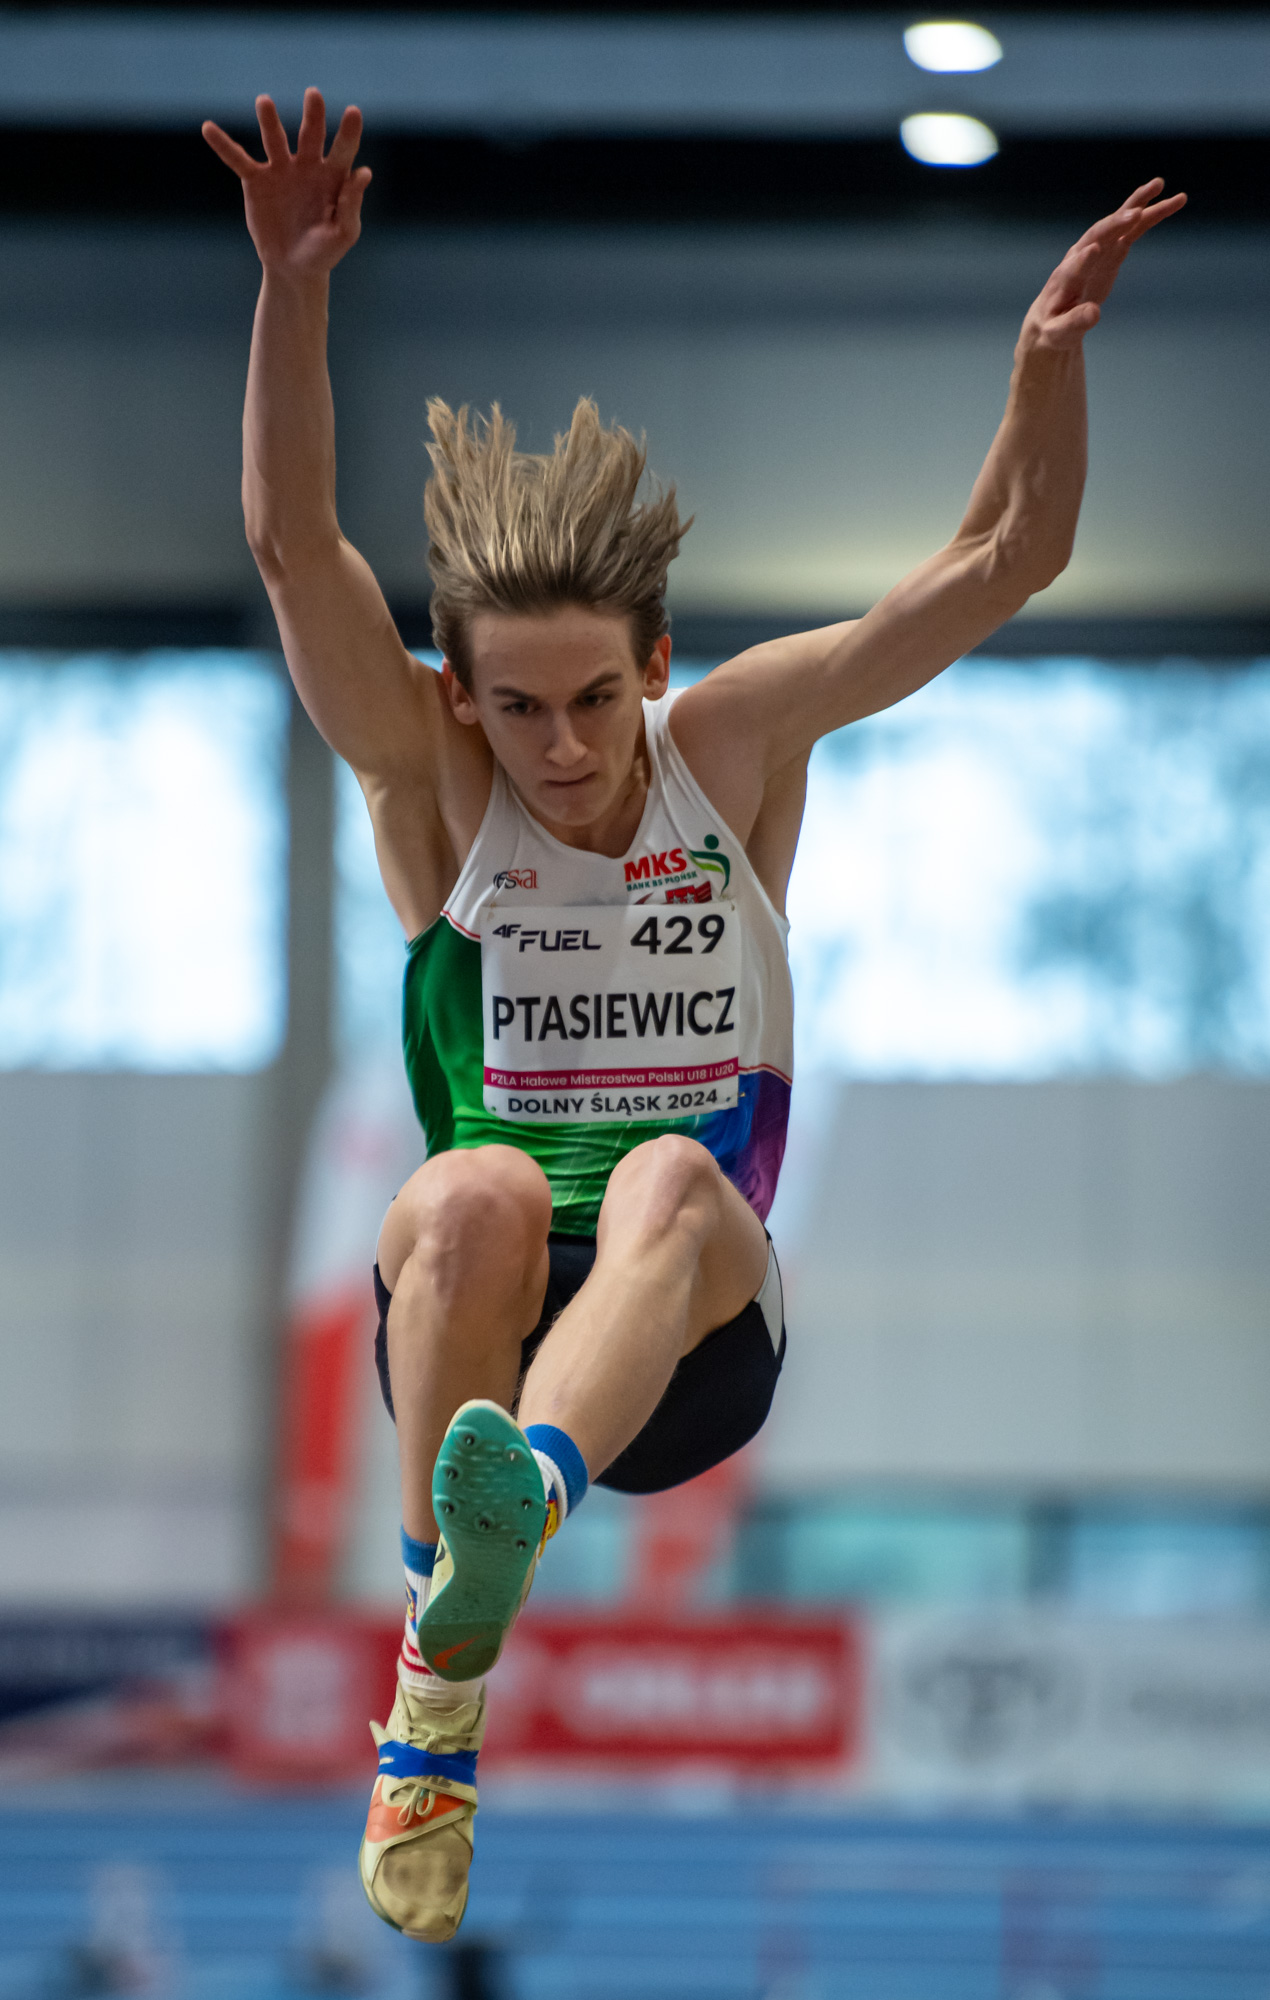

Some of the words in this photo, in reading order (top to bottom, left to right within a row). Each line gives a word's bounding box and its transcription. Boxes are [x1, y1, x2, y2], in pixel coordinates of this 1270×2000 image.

[624, 848, 687, 882] MKS
[626, 880, 650, 892] BANK
[652, 877, 663, 887] BS
[492, 924, 521, 938] 4F
[518, 930, 602, 952] FUEL
[630, 914, 725, 955] 429
[492, 986, 736, 1042] PTASIEWICZ
[491, 1072, 517, 1086] PZLA
[520, 1075, 568, 1086] Halowe
[570, 1073, 645, 1085] Mistrzostwa
[648, 1071, 684, 1083] Polski
[687, 1069, 707, 1081] U18
[715, 1062, 734, 1077] U20
[508, 1098, 584, 1114] DOLNY
[590, 1092, 661, 1116] ŚLĄSK
[667, 1088, 718, 1110] 2024
